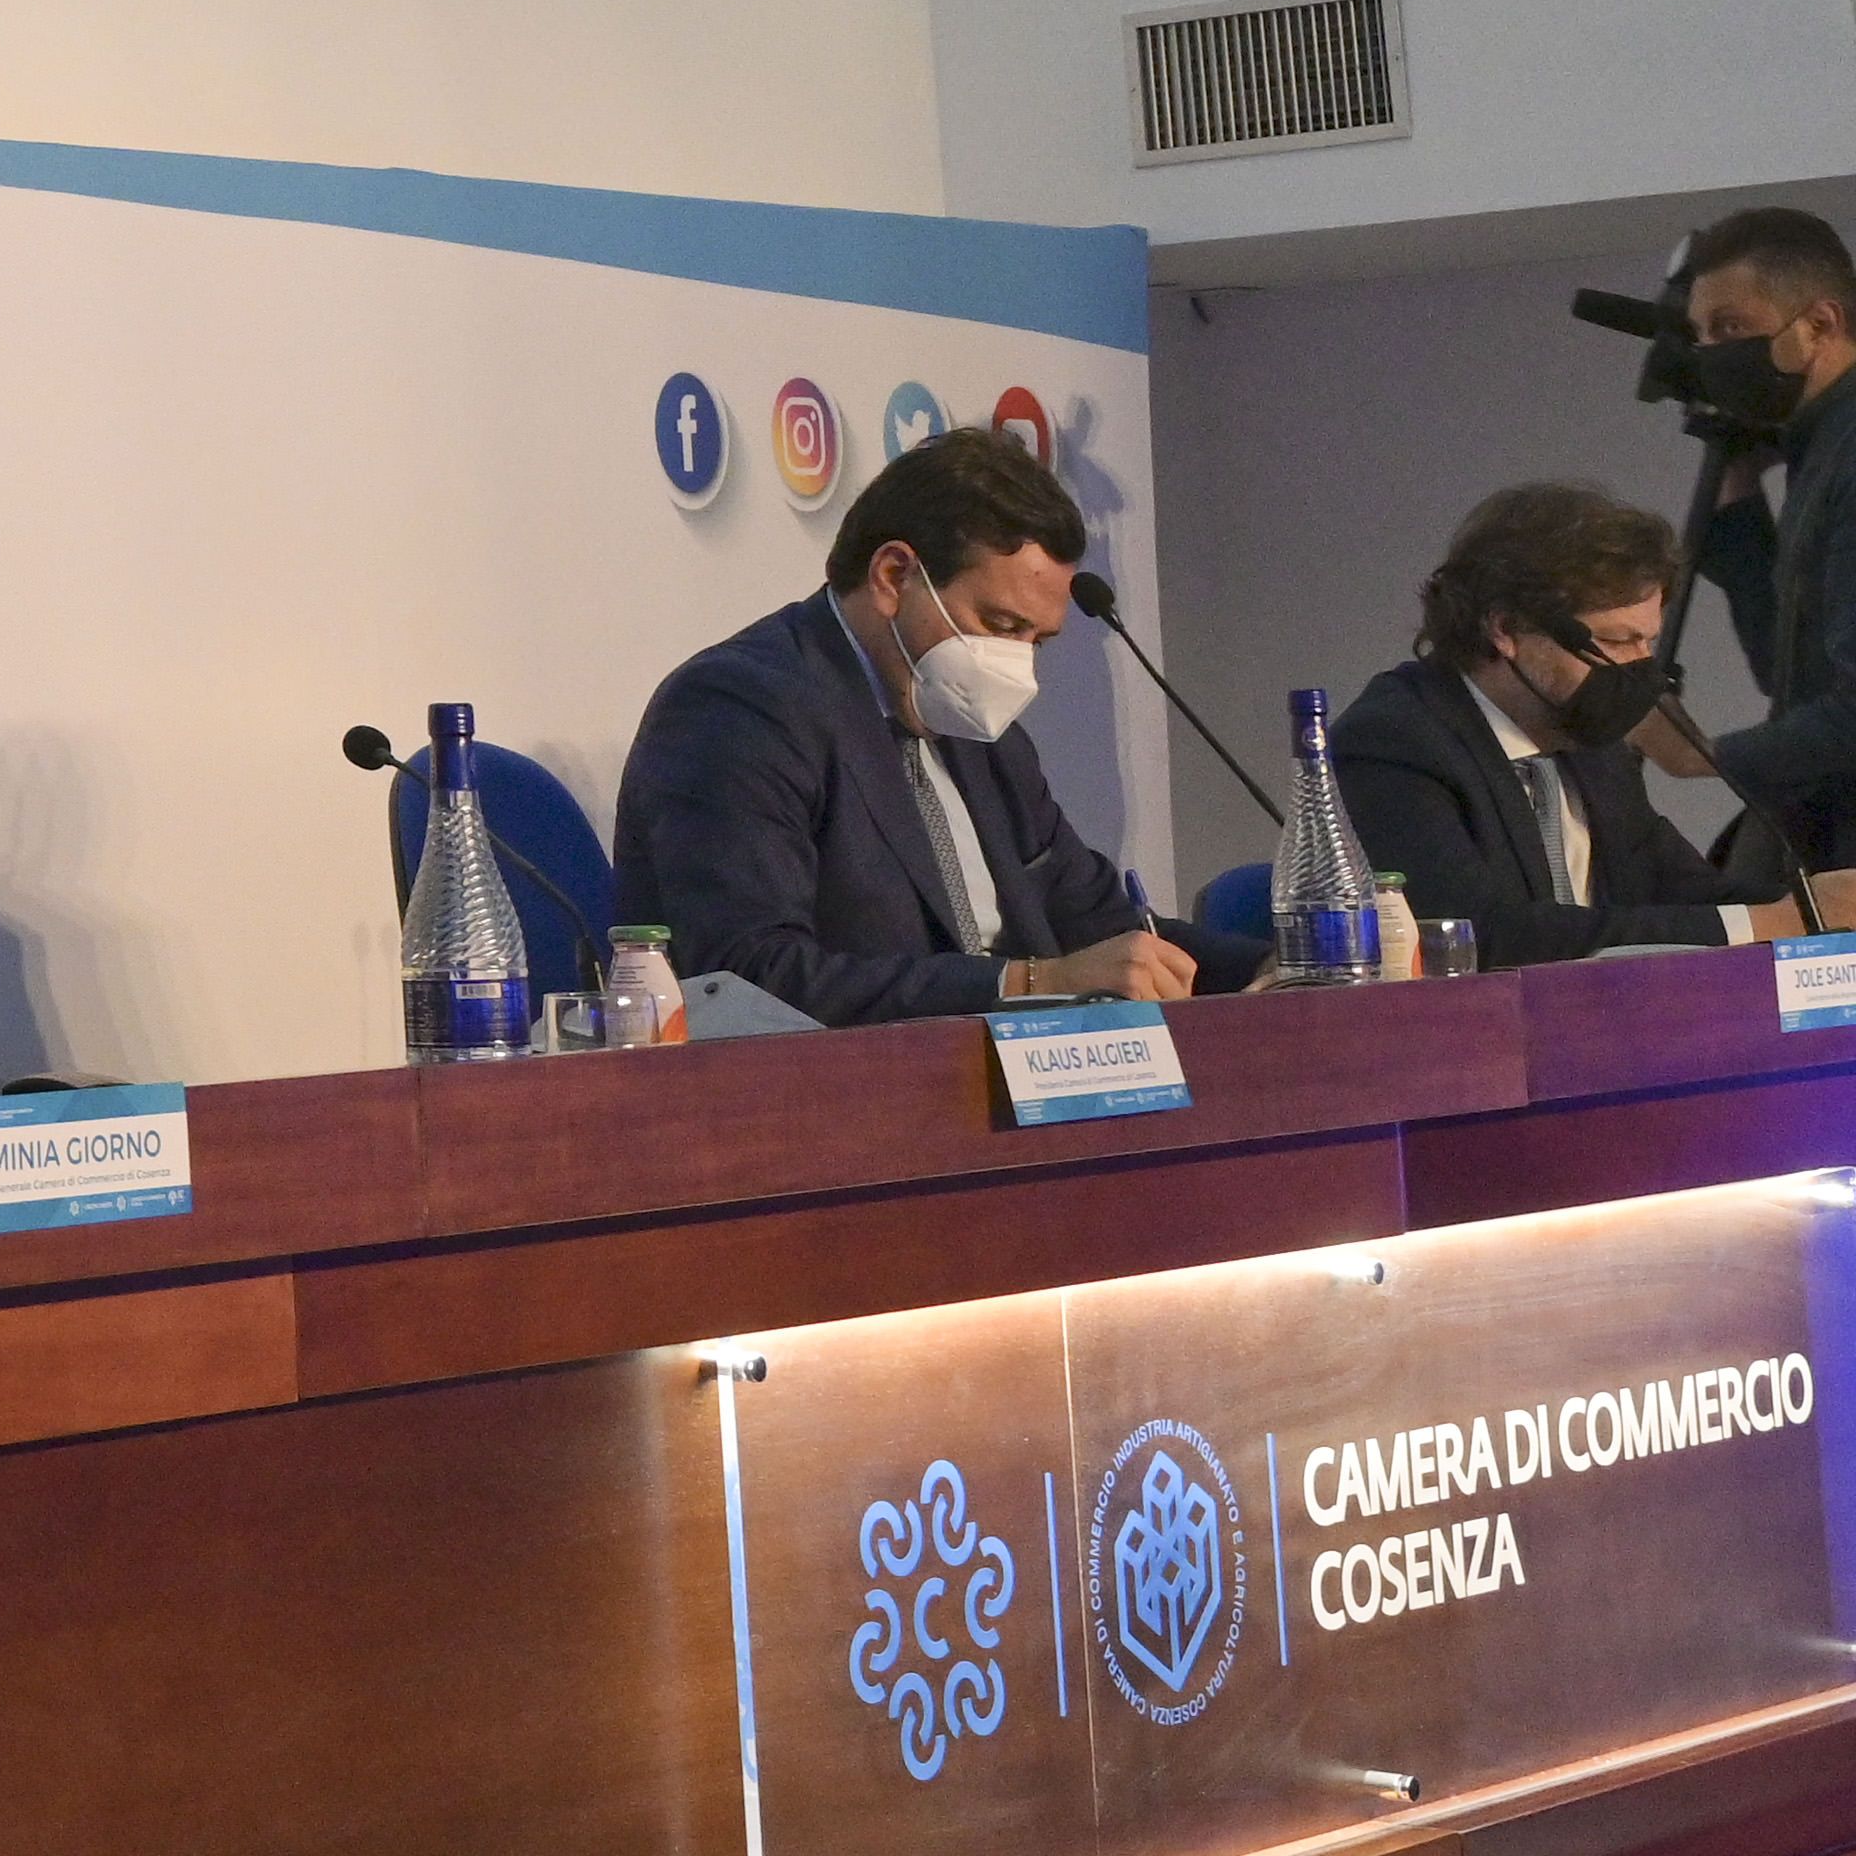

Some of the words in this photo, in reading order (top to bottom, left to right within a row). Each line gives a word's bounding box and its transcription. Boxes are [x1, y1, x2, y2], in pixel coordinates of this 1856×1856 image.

[1795, 968, 1824, 988] JOLE
[1025, 1047, 1082, 1073] KLAUS
[1087, 1040, 1151, 1067] ALGIERI
[66, 1130, 161, 1165] GIORNO
[1113, 1418, 1174, 1472] INDUSTRIA
[1303, 1416, 1501, 1527] CAMERA
[1505, 1404, 1552, 1485] DI
[1559, 1352, 1814, 1473] COMMERCIO
[1174, 1421, 1239, 1523] ARTIGIANATO
[1088, 1469, 1115, 1613] COMMERCIO
[1232, 1530, 1244, 1543] E
[1310, 1512, 1525, 1631] COSENZA
[1096, 1617, 1108, 1642] DI
[1206, 1552, 1246, 1699] AGRICOLTURA
[1103, 1643, 1146, 1716] CAMERA
[1150, 1697, 1206, 1725] COSENZA
